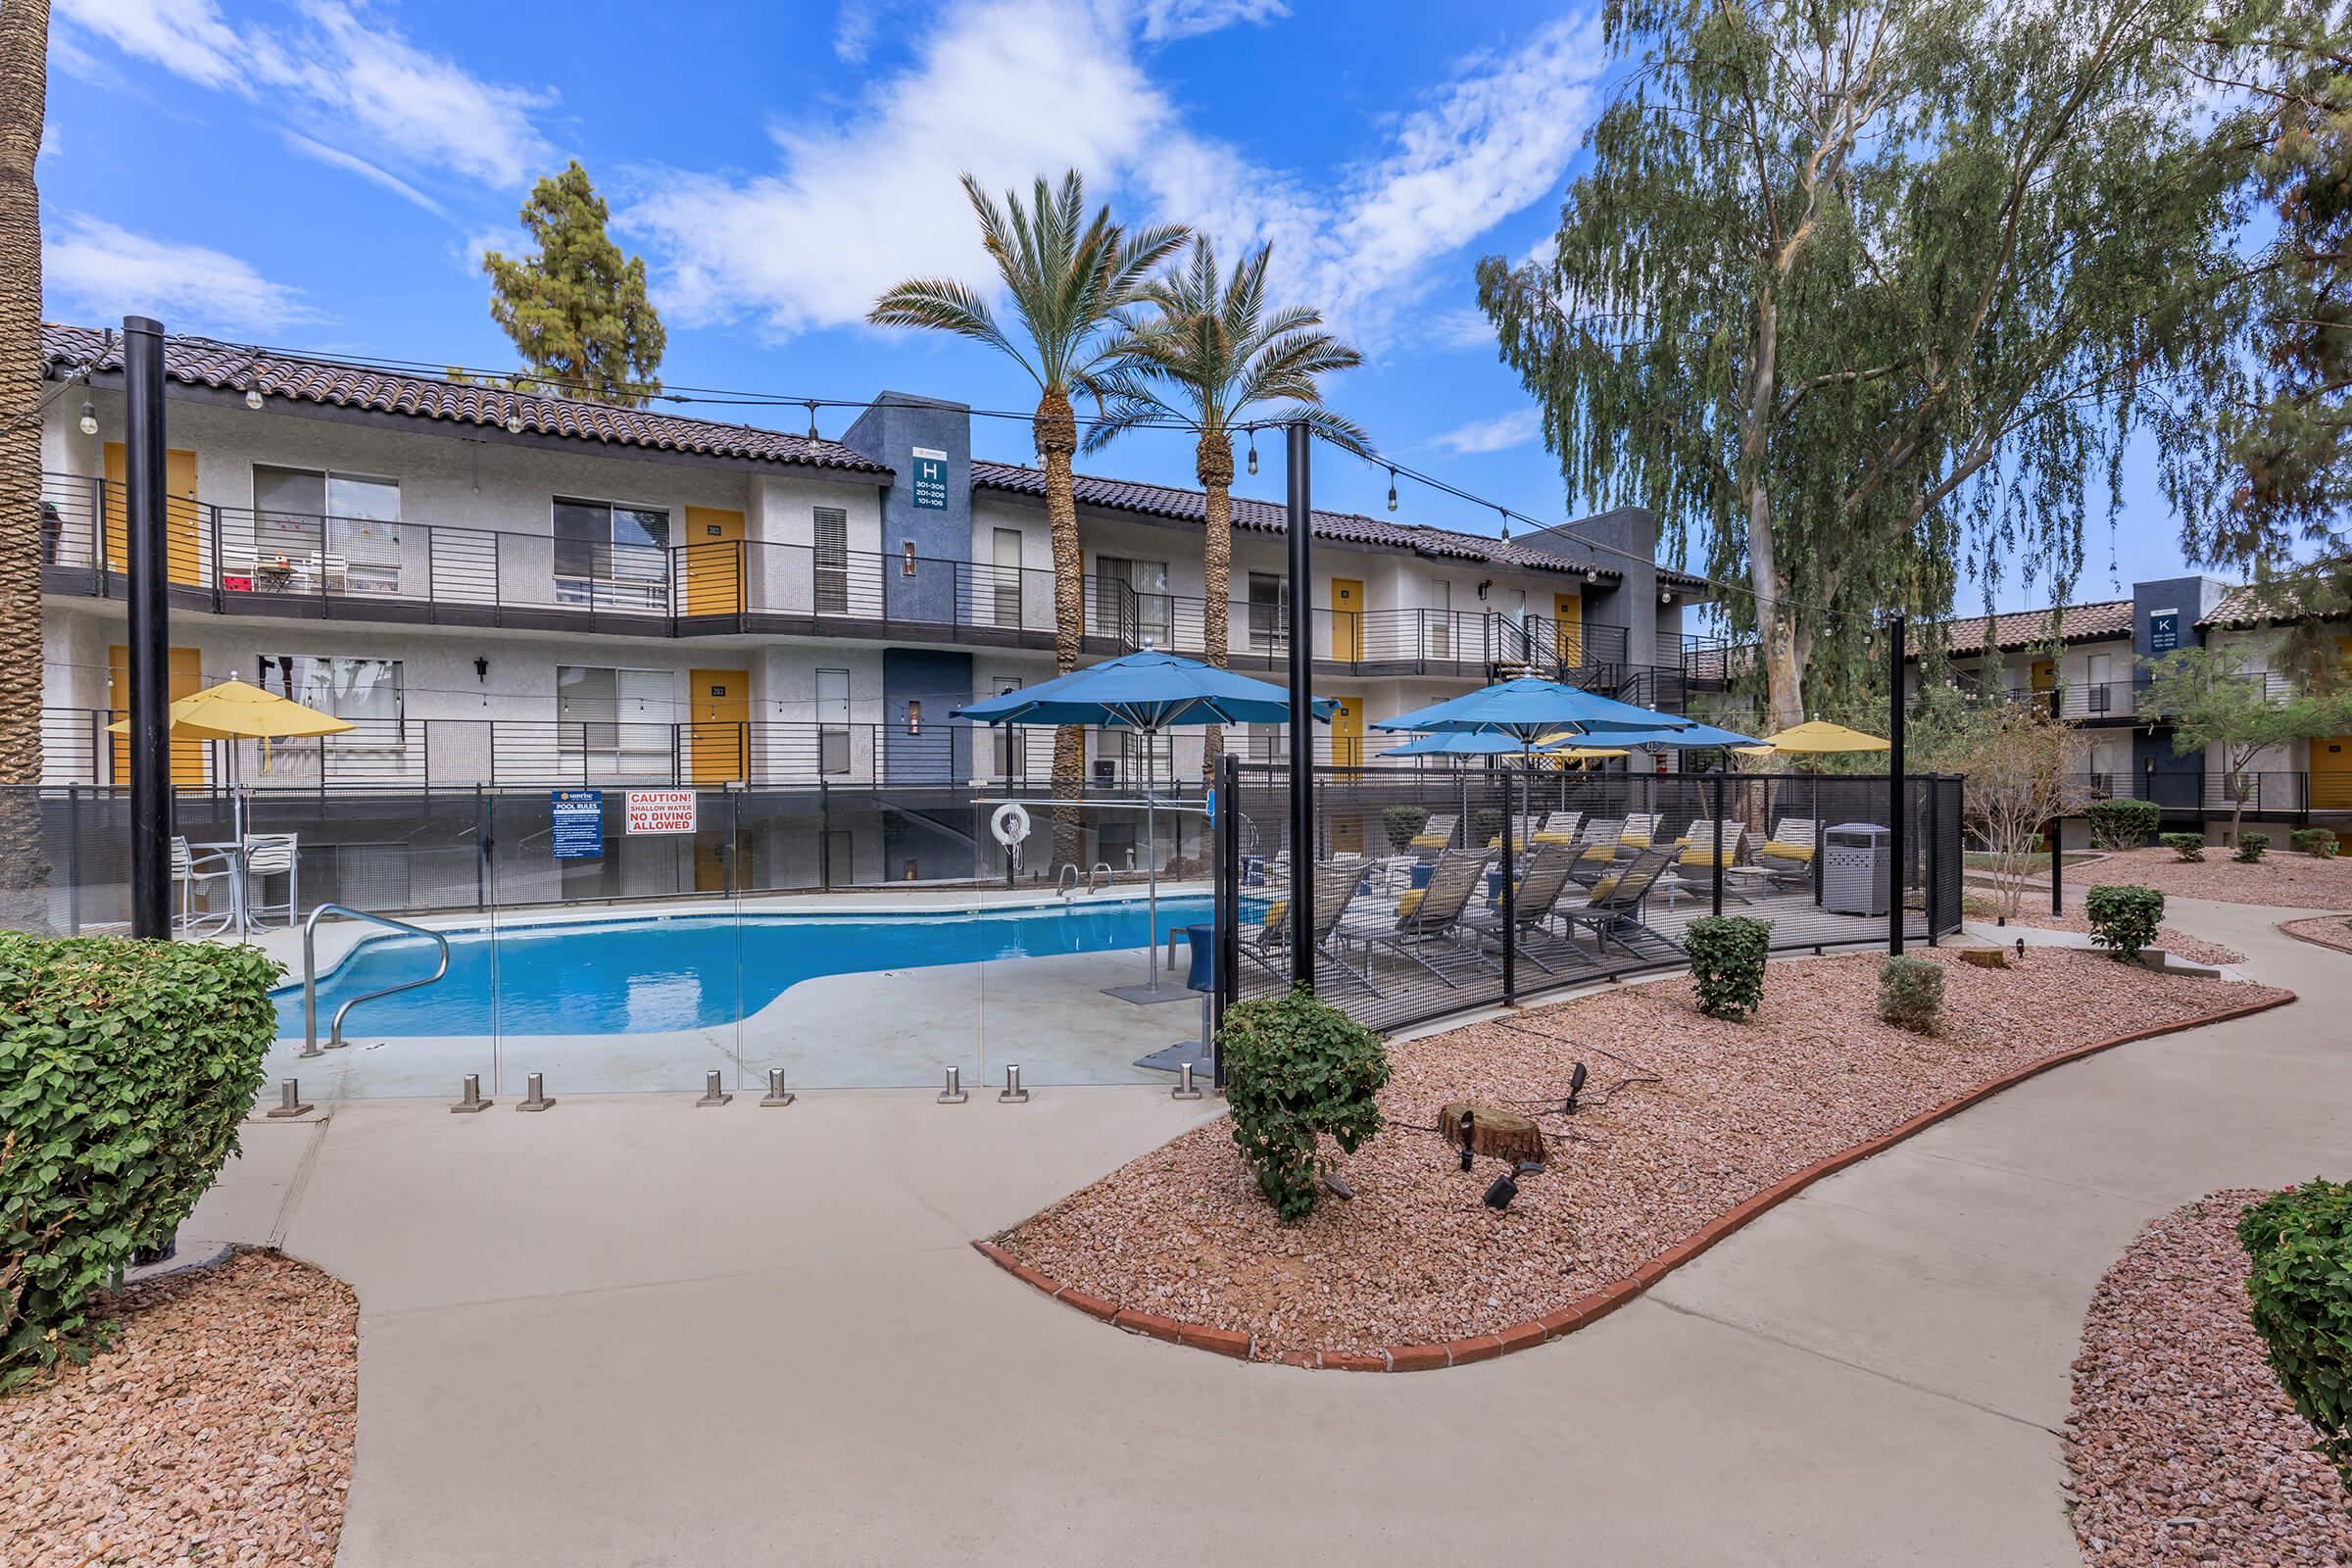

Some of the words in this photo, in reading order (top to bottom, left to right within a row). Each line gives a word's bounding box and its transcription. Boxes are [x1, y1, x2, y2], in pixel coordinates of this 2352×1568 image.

[923, 462, 937, 479] H
[2159, 619, 2170, 630] K
[631, 794, 691, 803] CAUTION!
[630, 812, 648, 821] NO
[651, 811, 693, 820] DIVING
[633, 820, 690, 830] ALLOWED
